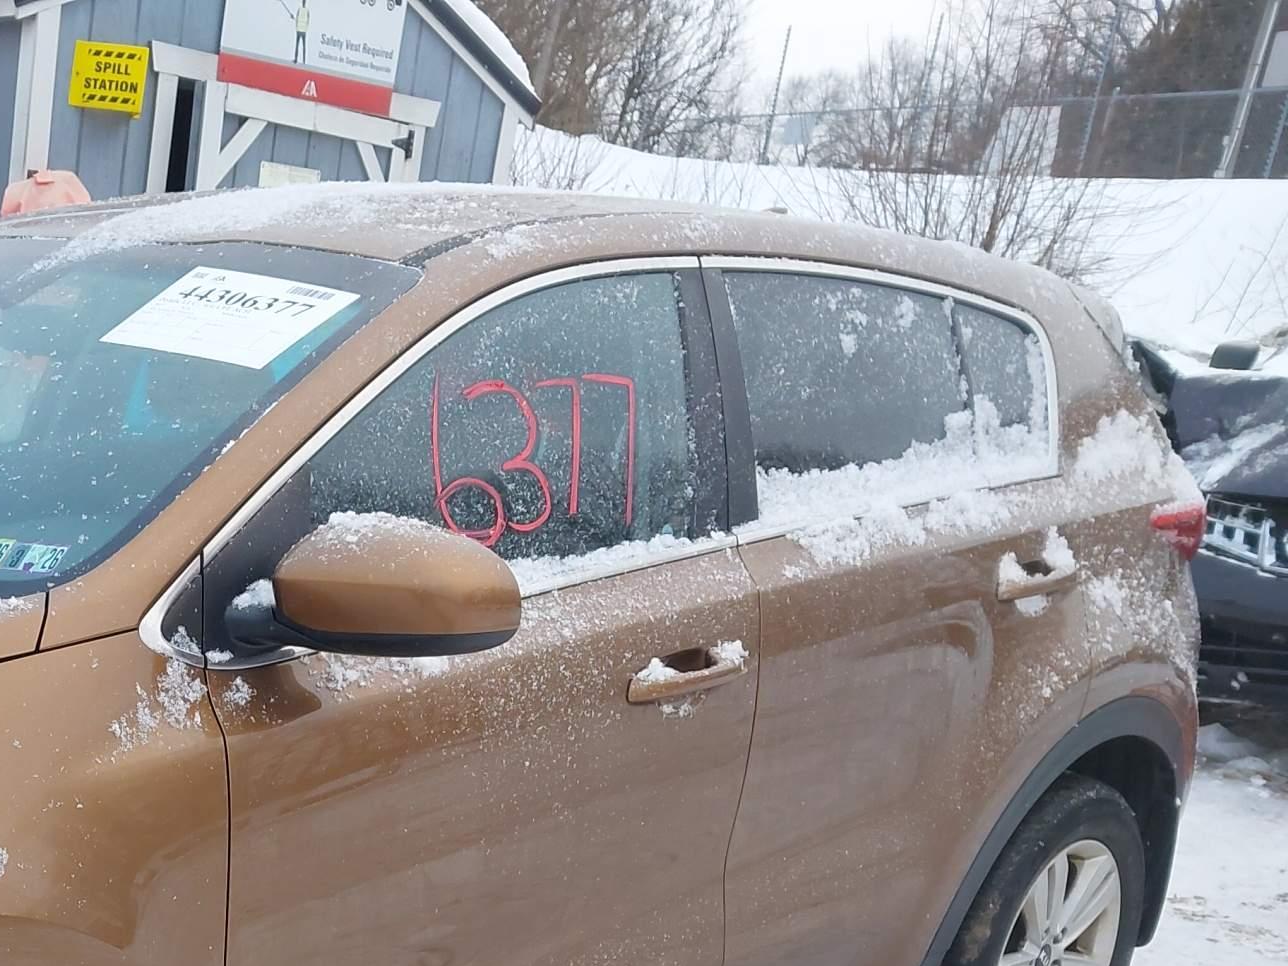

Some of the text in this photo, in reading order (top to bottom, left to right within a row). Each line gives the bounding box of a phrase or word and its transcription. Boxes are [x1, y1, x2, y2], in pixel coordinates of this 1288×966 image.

[320, 33, 394, 60] Safety Vest Required
[95, 61, 131, 76] SPILL
[84, 77, 138, 94] STATION
[179, 285, 316, 317] 44306377
[430, 370, 636, 547] 6377
[8, 548, 64, 570] 3 26
